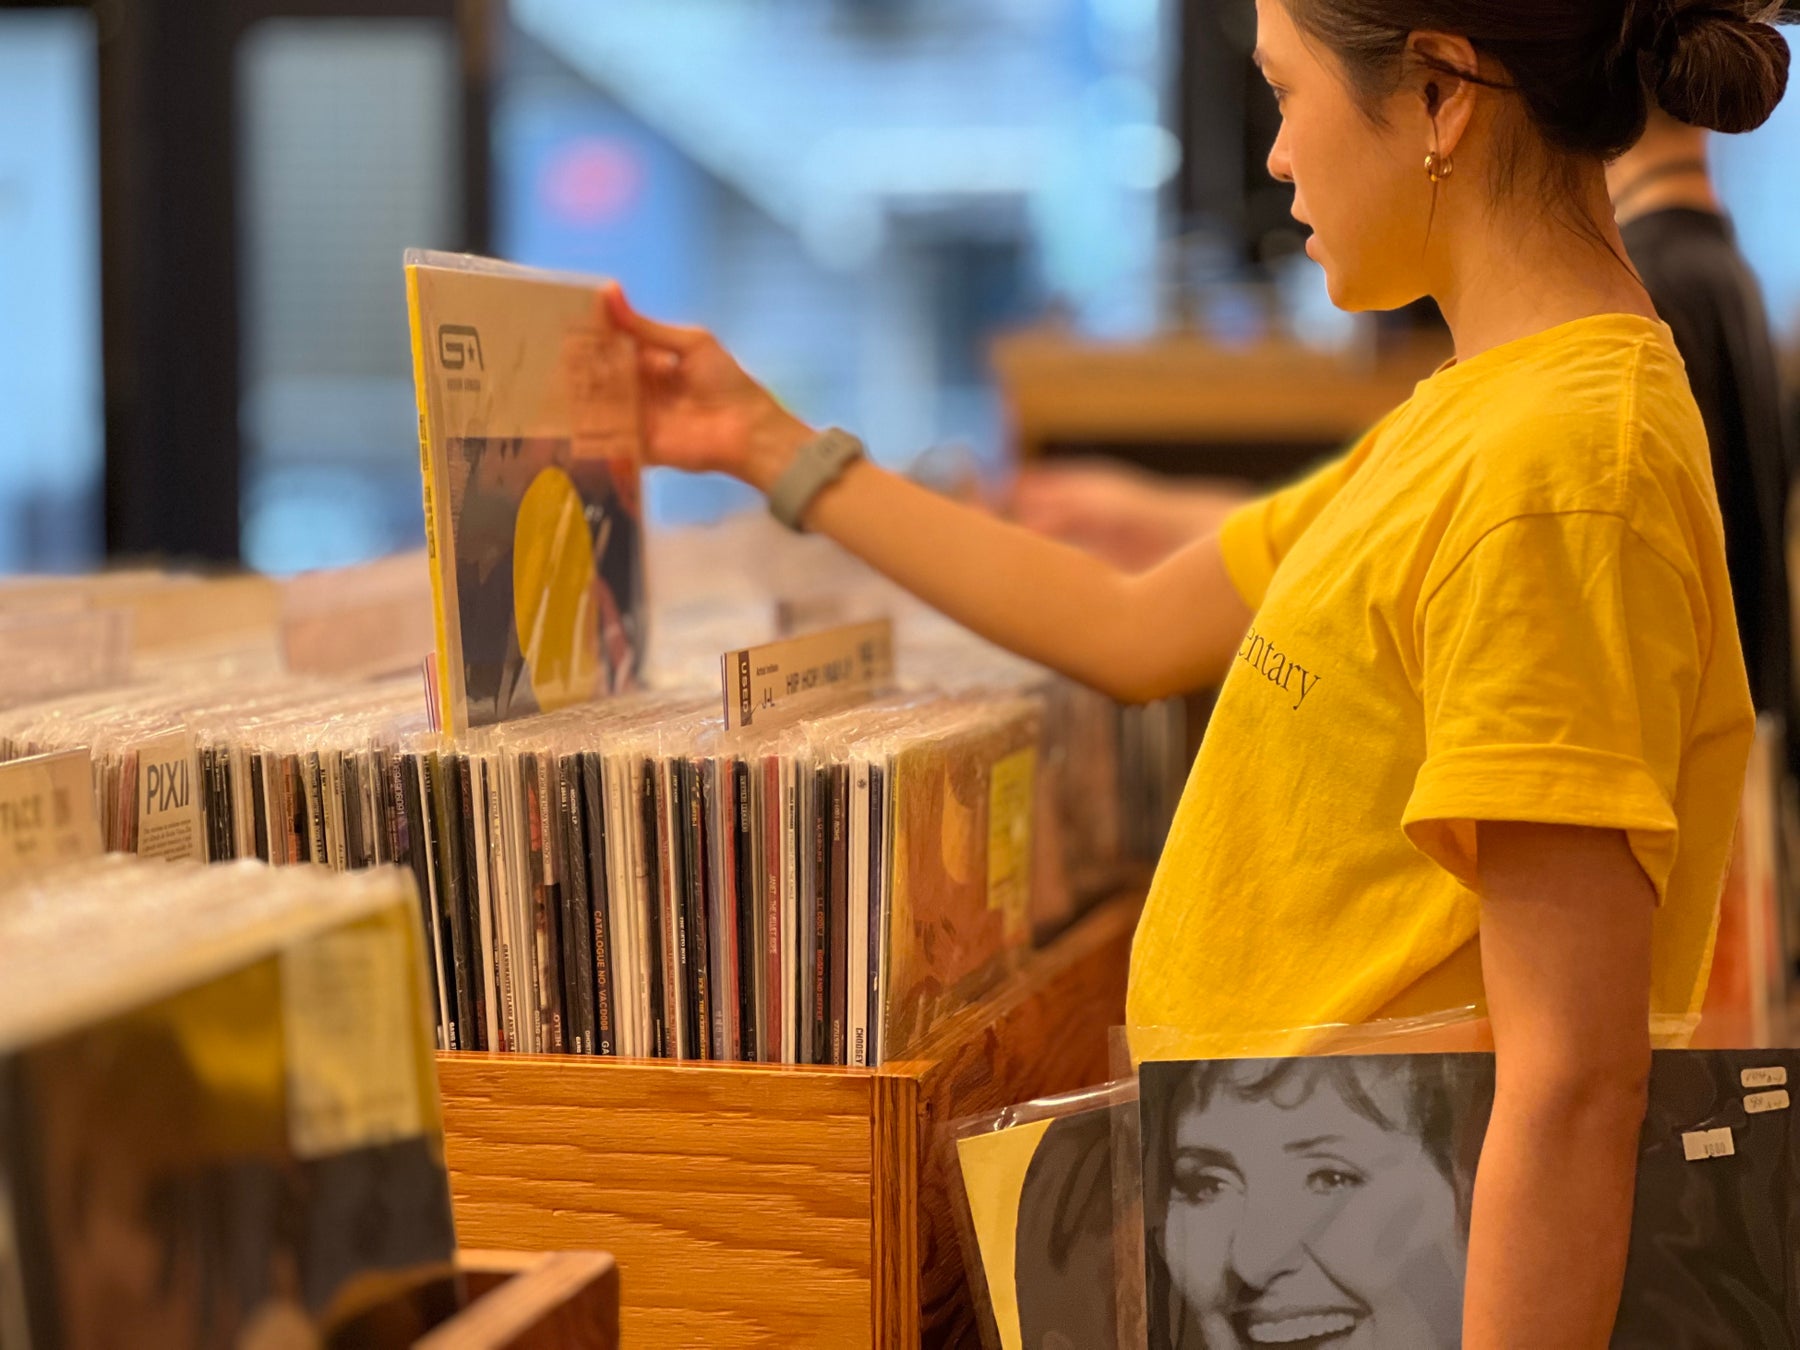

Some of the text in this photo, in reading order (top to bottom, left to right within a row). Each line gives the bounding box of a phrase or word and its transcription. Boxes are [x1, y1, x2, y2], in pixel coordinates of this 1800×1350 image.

[594, 910, 605, 967] CATALOGUE
[502, 944, 511, 994] GRANDMASTER
[599, 989, 609, 1031] VACD008
[855, 1027, 864, 1064] CHOOSEY
